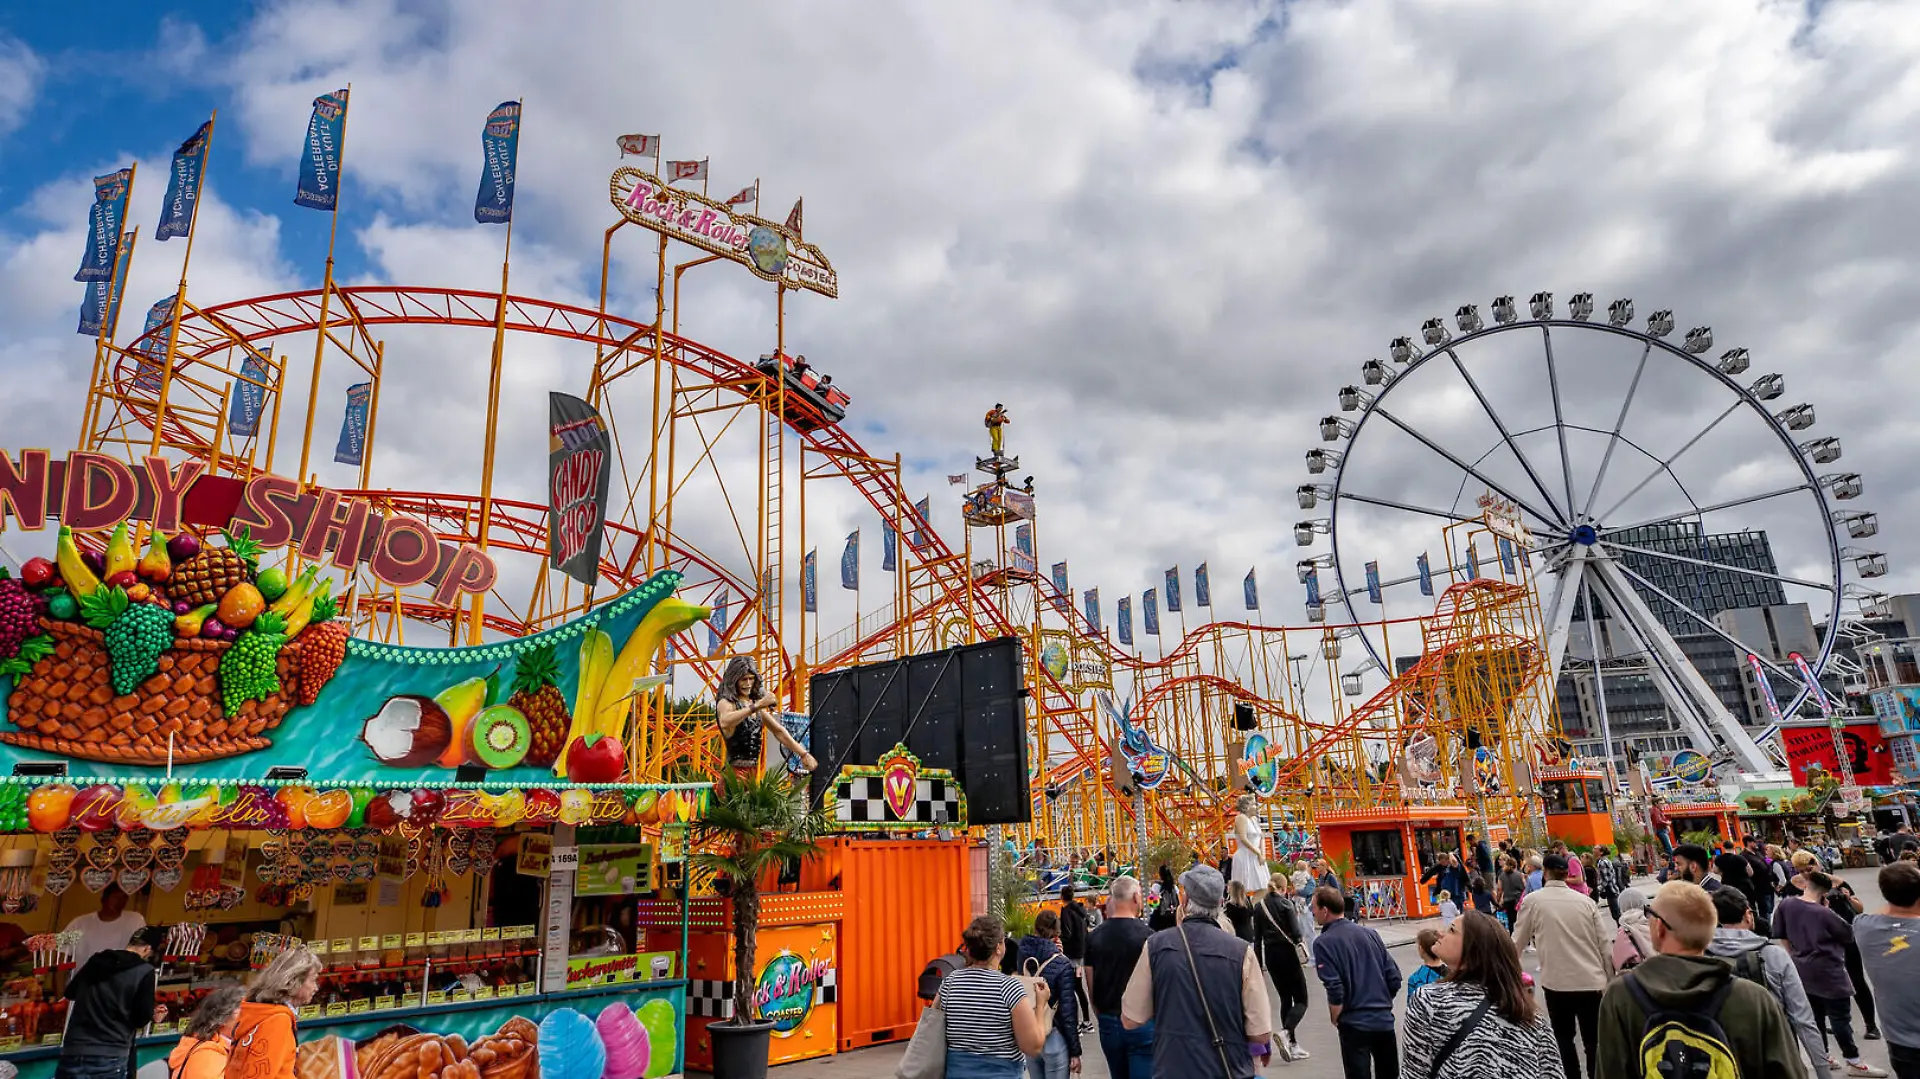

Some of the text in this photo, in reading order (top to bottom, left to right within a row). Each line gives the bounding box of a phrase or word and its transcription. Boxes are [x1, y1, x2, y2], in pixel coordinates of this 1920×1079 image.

[624, 182, 752, 251] Rock & Roller
[552, 449, 604, 516] CANDY
[229, 472, 498, 609] SHOP
[556, 500, 598, 569] SHOP
[443, 791, 627, 821] Zucertte
[889, 776, 911, 808] V
[773, 974, 787, 999] &
[787, 957, 832, 997] Roller
